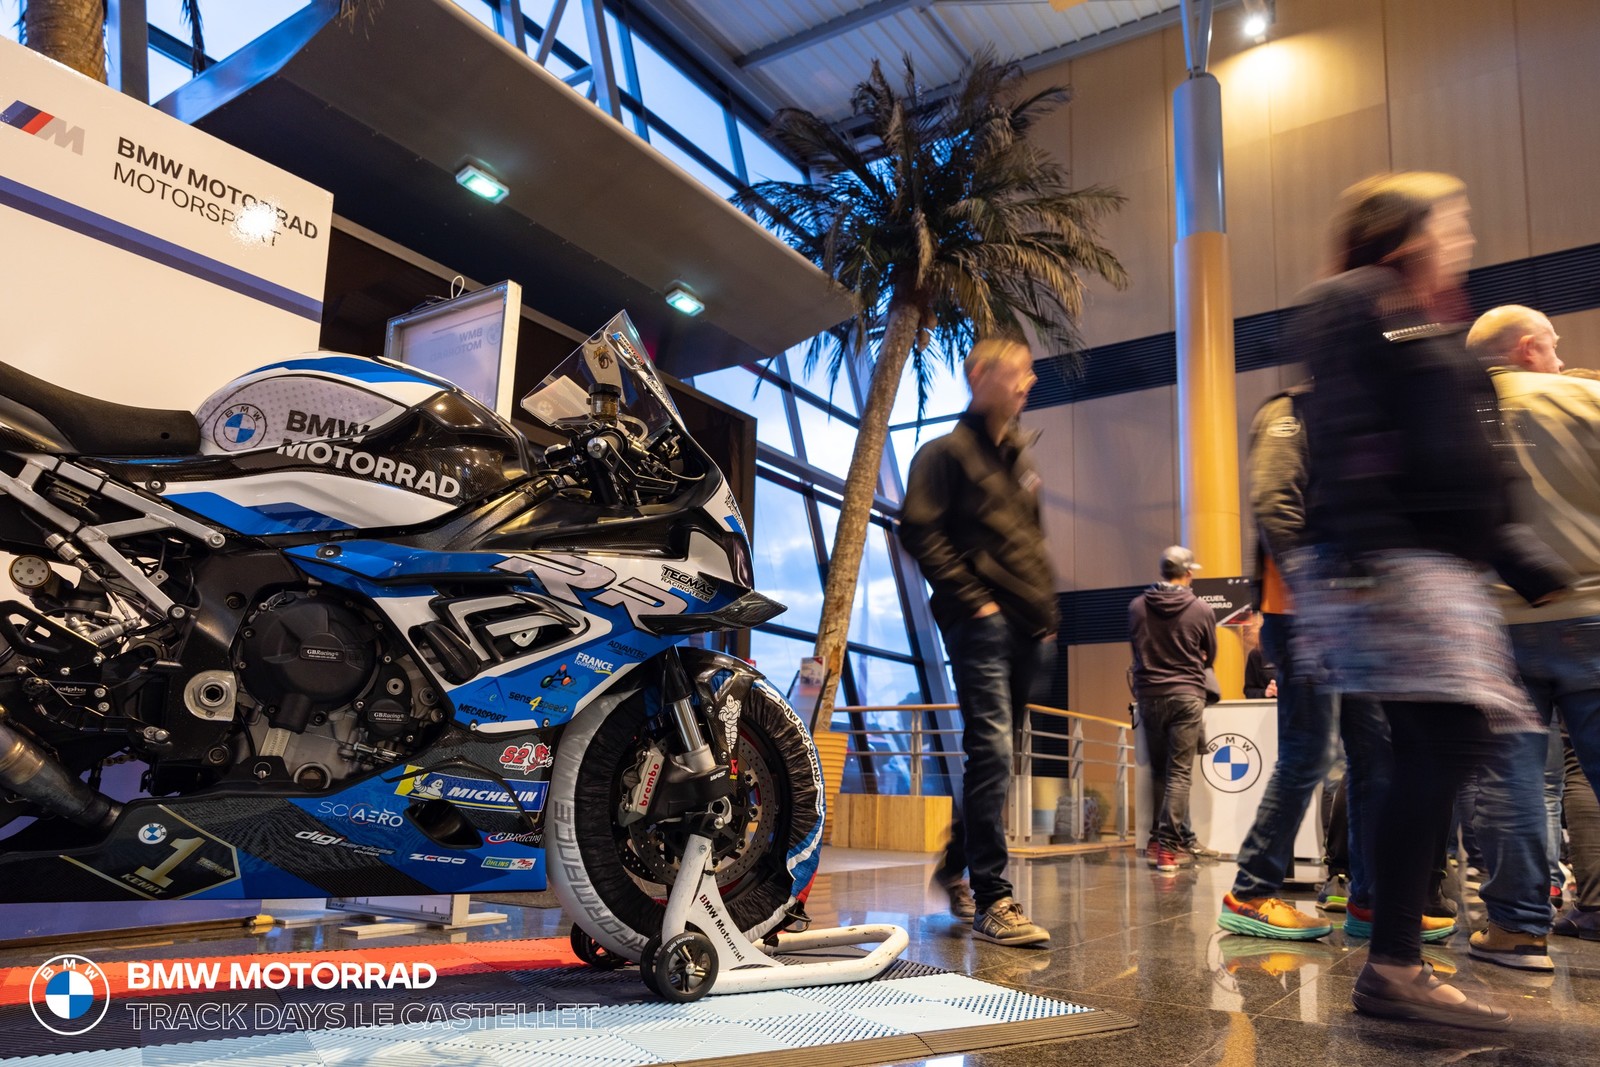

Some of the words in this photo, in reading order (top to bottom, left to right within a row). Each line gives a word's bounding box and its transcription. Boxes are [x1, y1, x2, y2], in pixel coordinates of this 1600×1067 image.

[117, 136, 183, 179] BMW
[187, 168, 318, 239] MOTORAD
[113, 162, 281, 247] MOTORSPT
[225, 406, 262, 421] BMW
[286, 409, 371, 443] BMW
[276, 438, 460, 498] MOTORRAD
[661, 577, 690, 593] RACING
[662, 566, 716, 596] TECMAS
[608, 640, 648, 659] ADVANTEC
[576, 652, 614, 672] FRANCE
[458, 703, 507, 723] MECASPORT
[1209, 736, 1253, 752] BMW
[500, 746, 530, 765] S2
[639, 763, 660, 807] brembo
[495, 831, 543, 844] GBRacing
[134, 836, 206, 889] 1
[121, 873, 168, 895] KENNY
[699, 894, 719, 919] BMW
[715, 919, 745, 962] Motorrad
